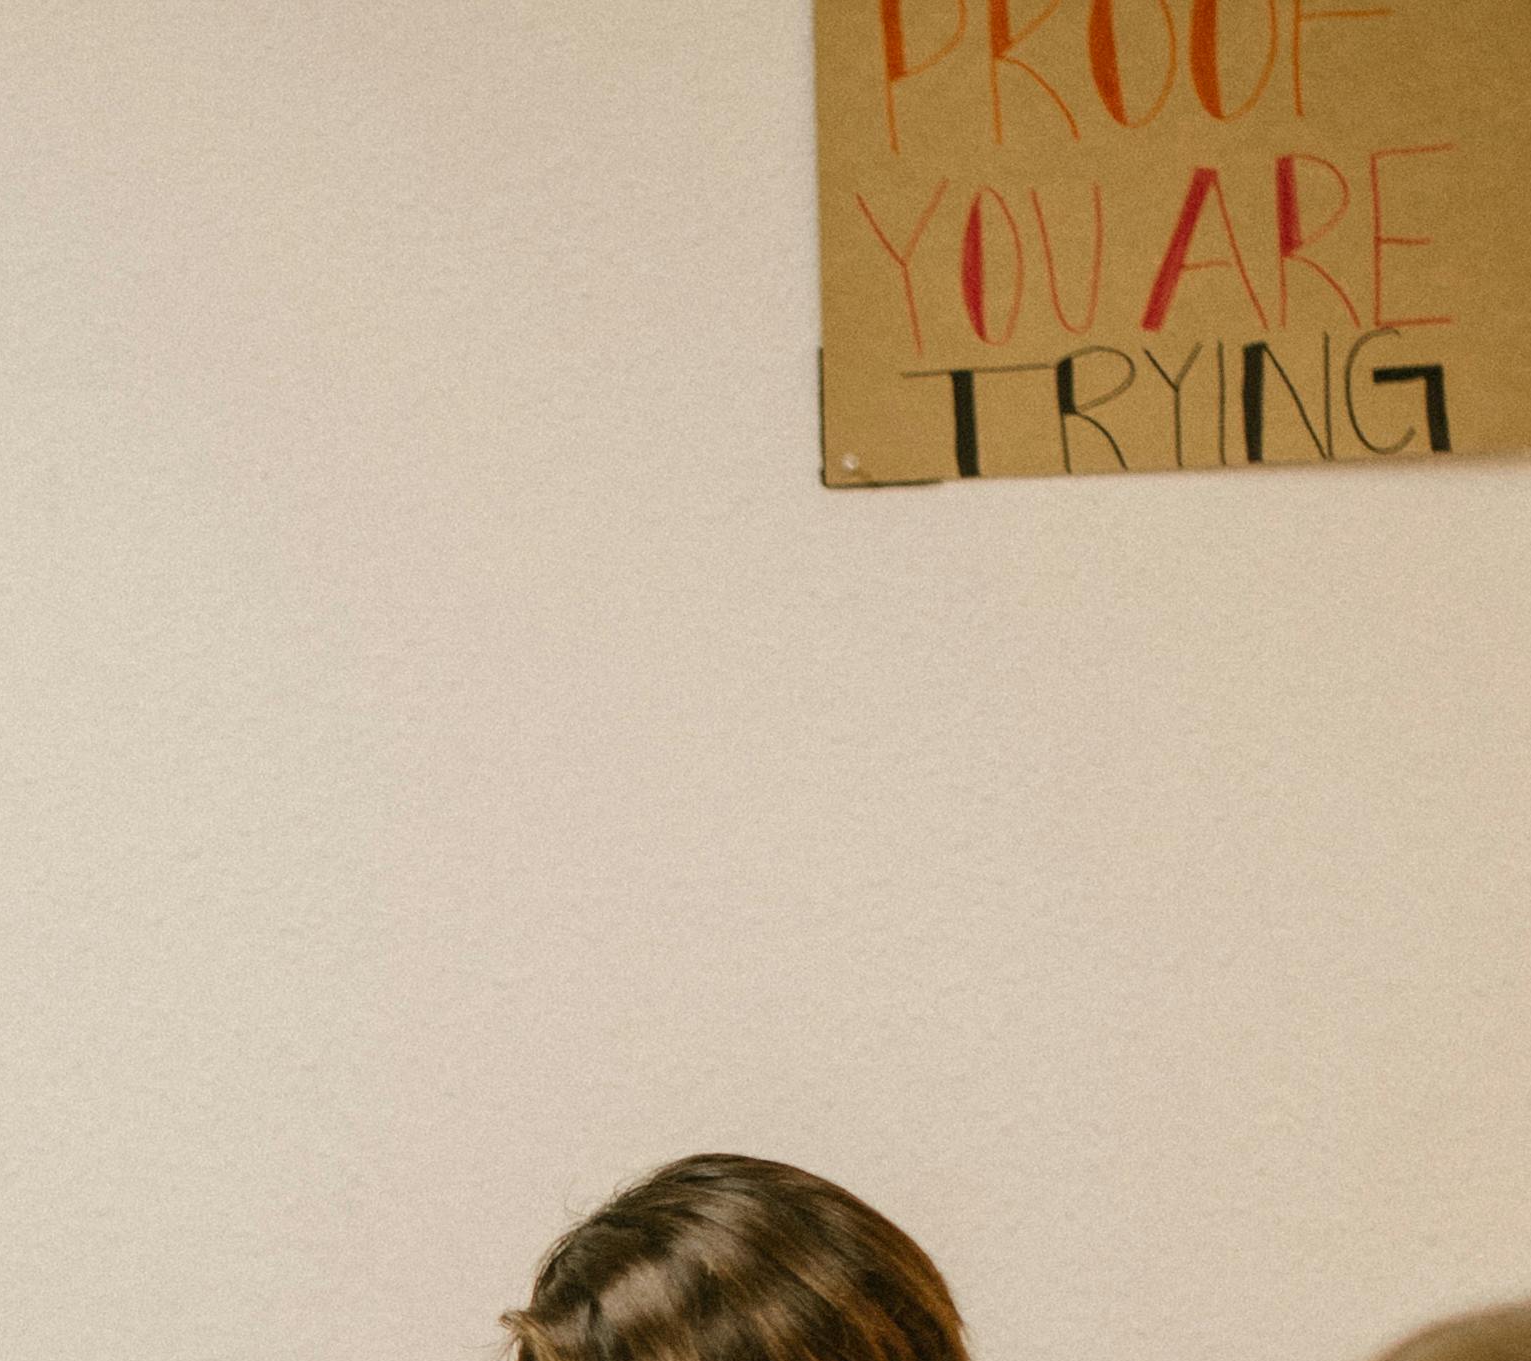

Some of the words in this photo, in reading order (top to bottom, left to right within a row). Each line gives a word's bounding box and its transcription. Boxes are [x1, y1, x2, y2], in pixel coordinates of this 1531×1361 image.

[856, 178, 1106, 359] YOU
[1141, 143, 1456, 332] ARE
[900, 327, 1453, 479] TRYING
